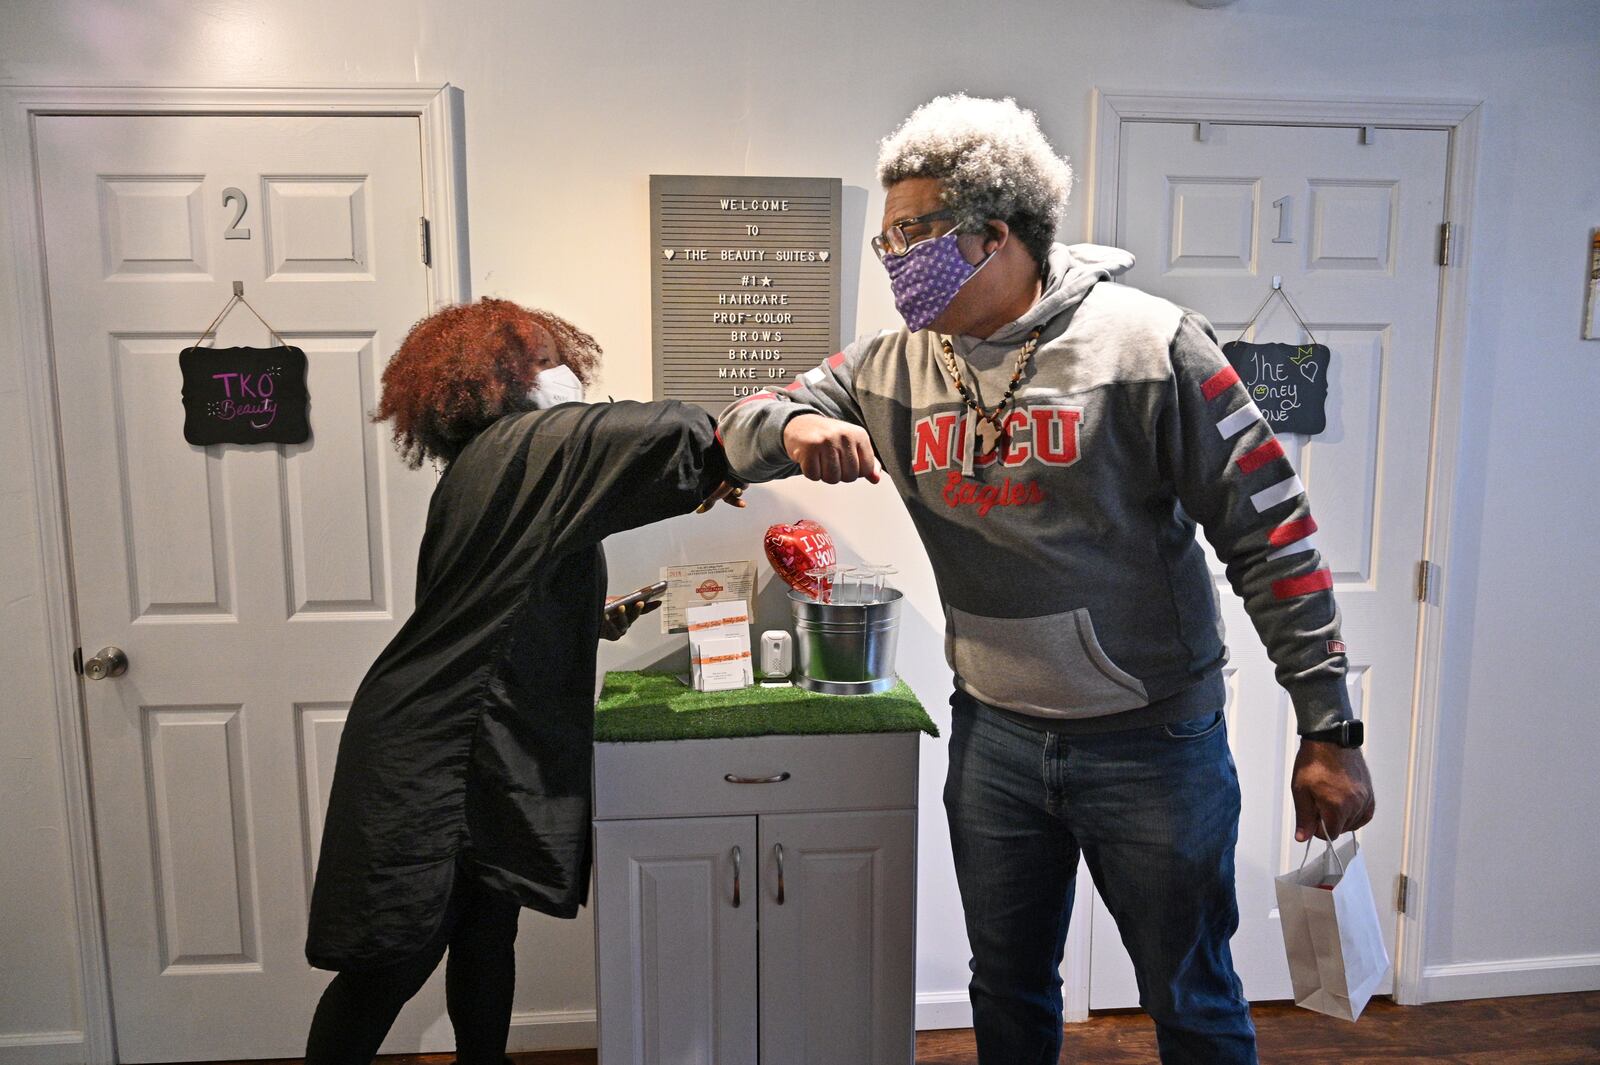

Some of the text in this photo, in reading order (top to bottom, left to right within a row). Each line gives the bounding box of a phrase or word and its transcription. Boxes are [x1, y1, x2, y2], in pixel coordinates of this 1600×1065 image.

[720, 199, 789, 211] WELCOME
[221, 187, 250, 240] 2
[1271, 195, 1295, 244] 1
[745, 224, 759, 236] TO
[684, 249, 815, 262] THE BEAUTY SUITES
[741, 275, 757, 286] #1
[719, 294, 789, 305] HAIRCARE
[731, 331, 782, 342] BROWS
[729, 350, 780, 360] BRAIDS
[719, 368, 786, 378] MAKE UP
[212, 373, 274, 399] TKO
[217, 398, 278, 429] Beauty
[942, 470, 1047, 519] Eagles
[800, 536, 813, 553] I
[815, 547, 835, 567] YOU
